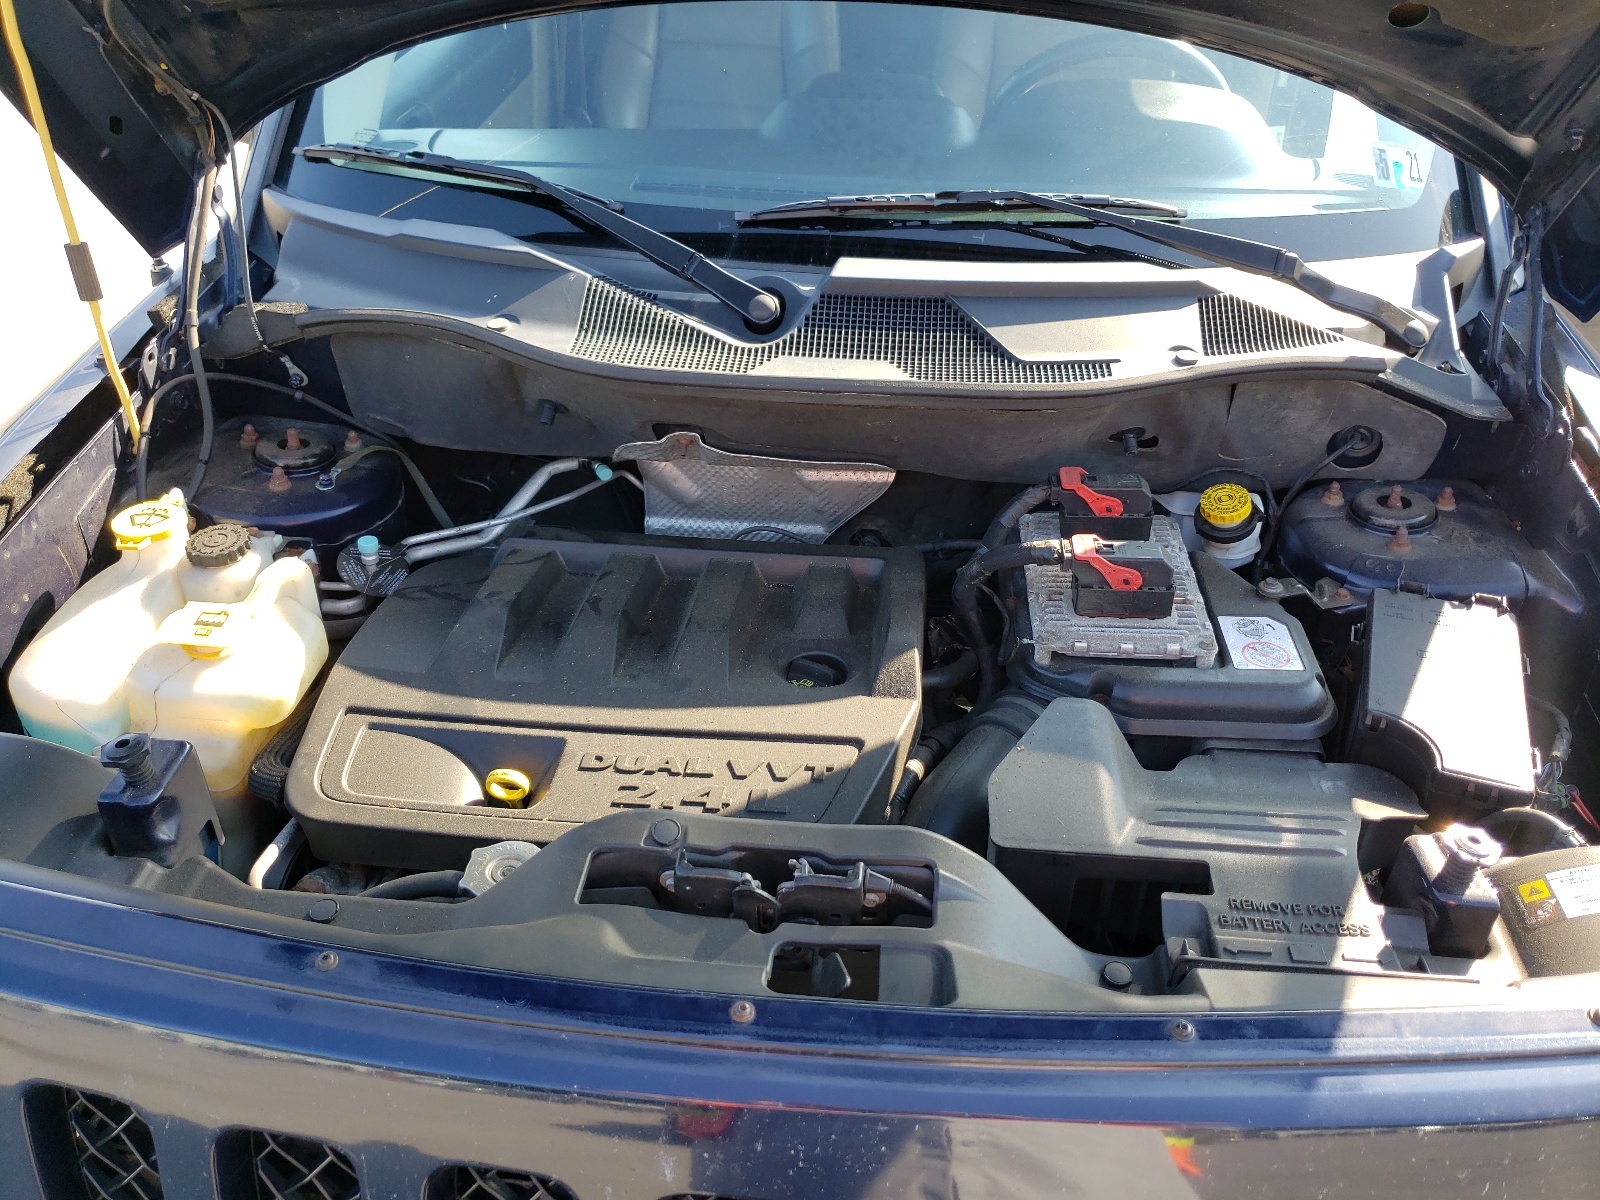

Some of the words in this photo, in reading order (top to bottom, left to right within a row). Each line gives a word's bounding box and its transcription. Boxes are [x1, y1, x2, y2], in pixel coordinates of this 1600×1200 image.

[1405, 150, 1423, 183] 21
[577, 753, 714, 777] DUAL
[726, 760, 835, 782] VVT
[610, 784, 788, 814] 2.4L
[1228, 897, 1304, 915] REMOVE
[1307, 903, 1346, 918] FOR
[1218, 914, 1293, 932] BATTERY
[1300, 922, 1371, 937] ACCESS
